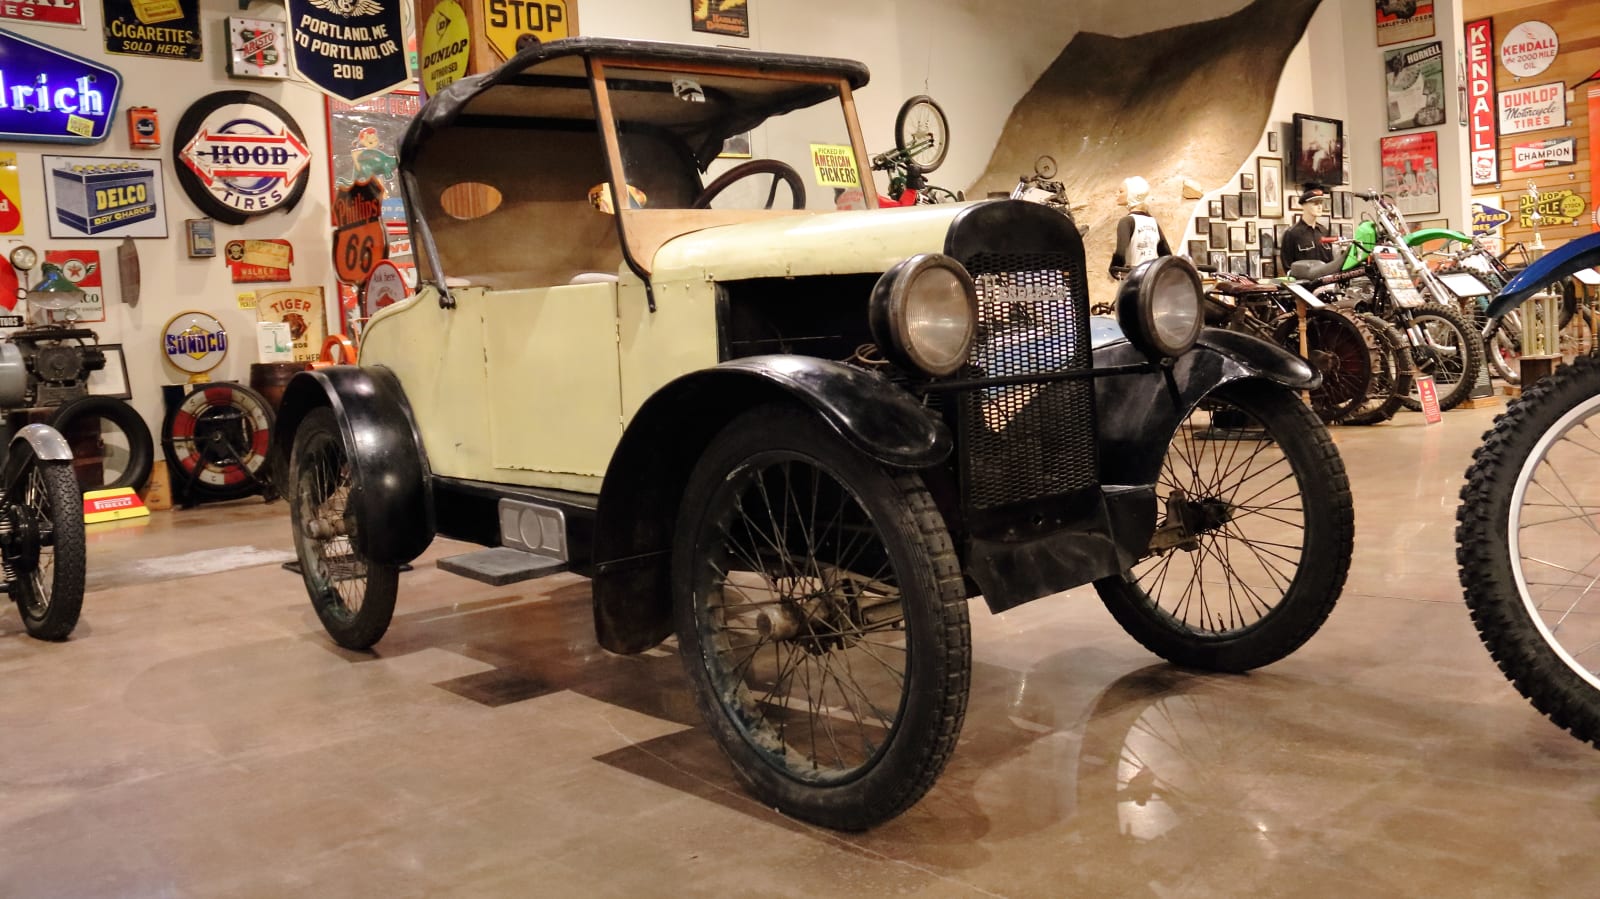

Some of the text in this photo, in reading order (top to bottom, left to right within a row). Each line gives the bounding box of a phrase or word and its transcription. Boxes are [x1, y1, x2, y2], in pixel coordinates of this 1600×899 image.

[490, 0, 562, 32] STOP
[111, 20, 194, 44] CIGARETTES
[300, 14, 388, 41] PORTLAND, ME
[122, 40, 152, 52] SOLD
[243, 32, 274, 57] ARISTO
[295, 28, 399, 60] TO PORTLAND, OR
[423, 38, 468, 69] DUNLOP
[1503, 38, 1556, 56] KENDALL
[1406, 44, 1440, 64] HORNELL
[1517, 52, 1537, 62] 2000
[1538, 49, 1555, 58] MILE
[332, 63, 364, 80] 2018
[1523, 62, 1536, 70] OIL
[1470, 25, 1491, 150] KENDALL
[1504, 87, 1558, 108] DUNLOP
[1504, 101, 1559, 120] Motorcycle
[1514, 115, 1550, 129] TIRES
[211, 145, 289, 165] HOOD
[814, 151, 851, 168] AMERICAN
[817, 147, 838, 155] PICKED
[1518, 147, 1570, 161] CHAMPION
[819, 167, 857, 184] PICKERS
[95, 184, 146, 210] DELCO
[222, 191, 282, 210] TIRES
[1525, 201, 1560, 214] CCLE
[94, 214, 113, 226] DRY
[346, 233, 375, 273] 66
[270, 299, 311, 313] TIGER
[166, 330, 226, 355] SUNOCO
[93, 497, 132, 510] PIRELLI
